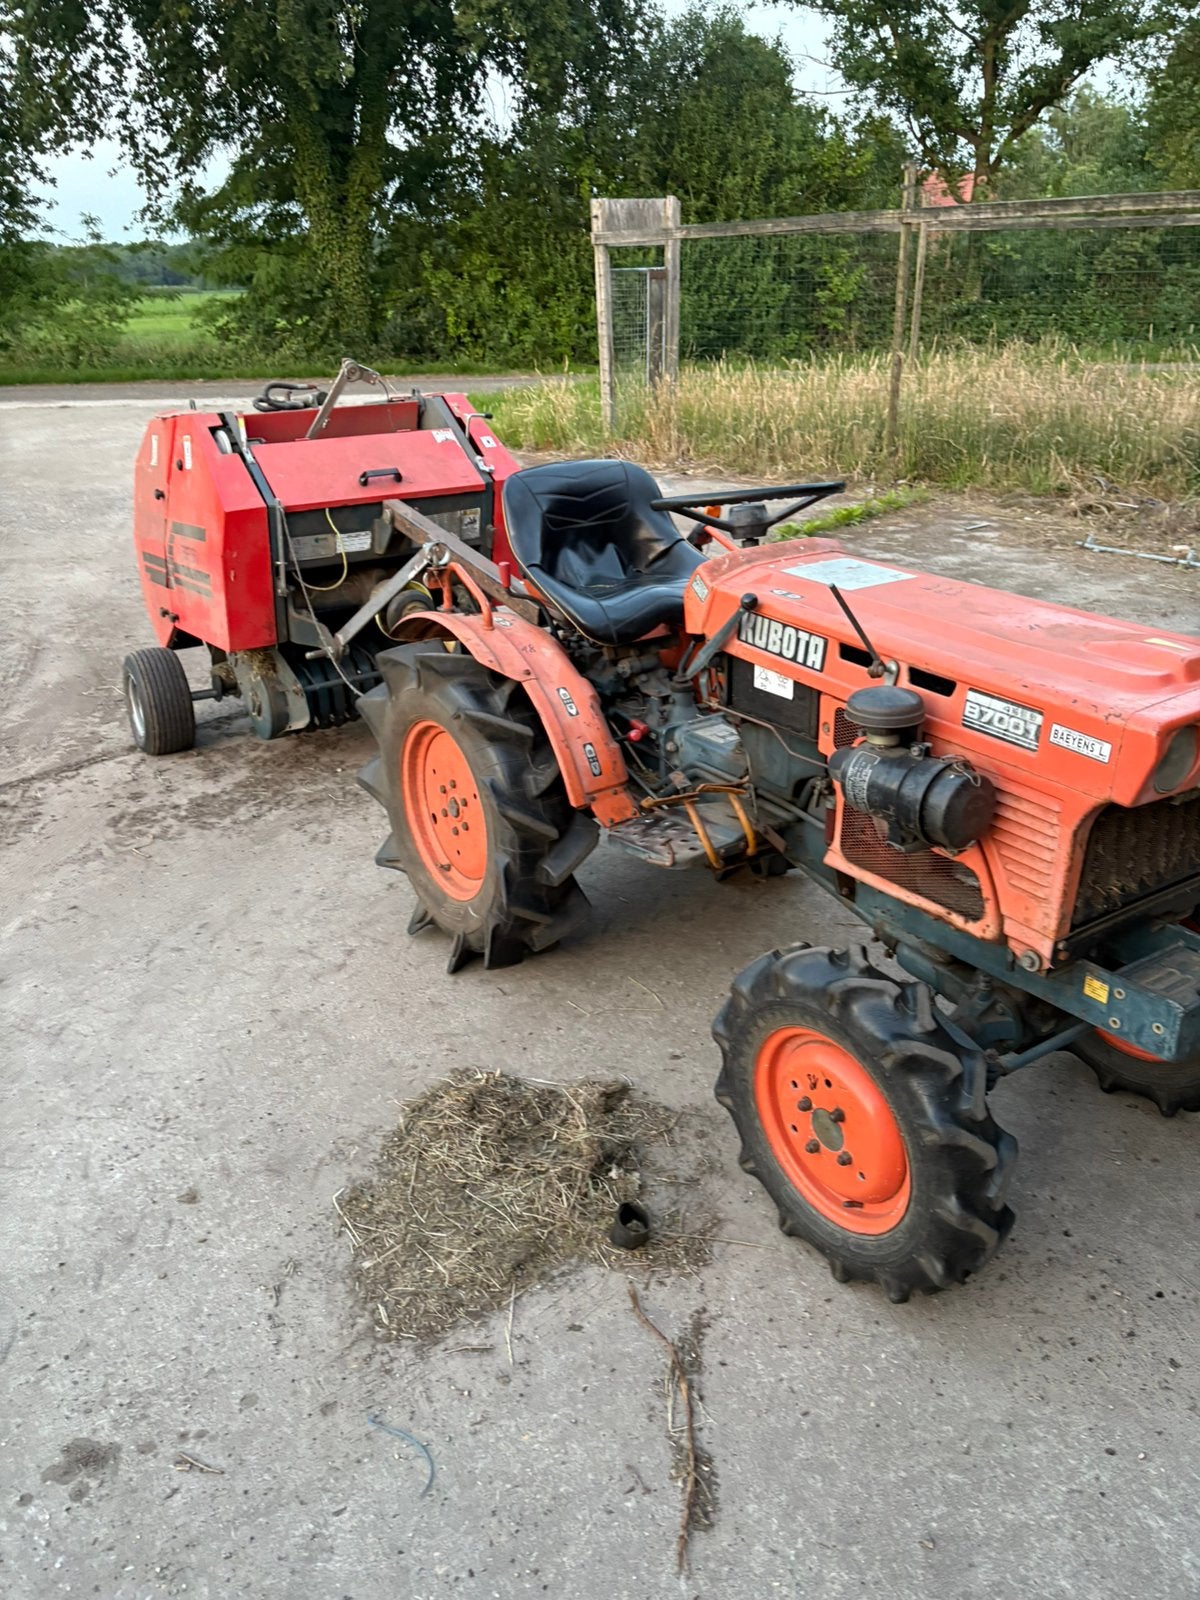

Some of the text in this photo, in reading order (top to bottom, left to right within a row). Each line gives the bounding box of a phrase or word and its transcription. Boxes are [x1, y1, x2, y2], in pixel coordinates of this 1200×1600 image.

[740, 612, 825, 670] KUBOTA
[964, 702, 1038, 740] B7001
[1053, 729, 1096, 753] BAEYENS
